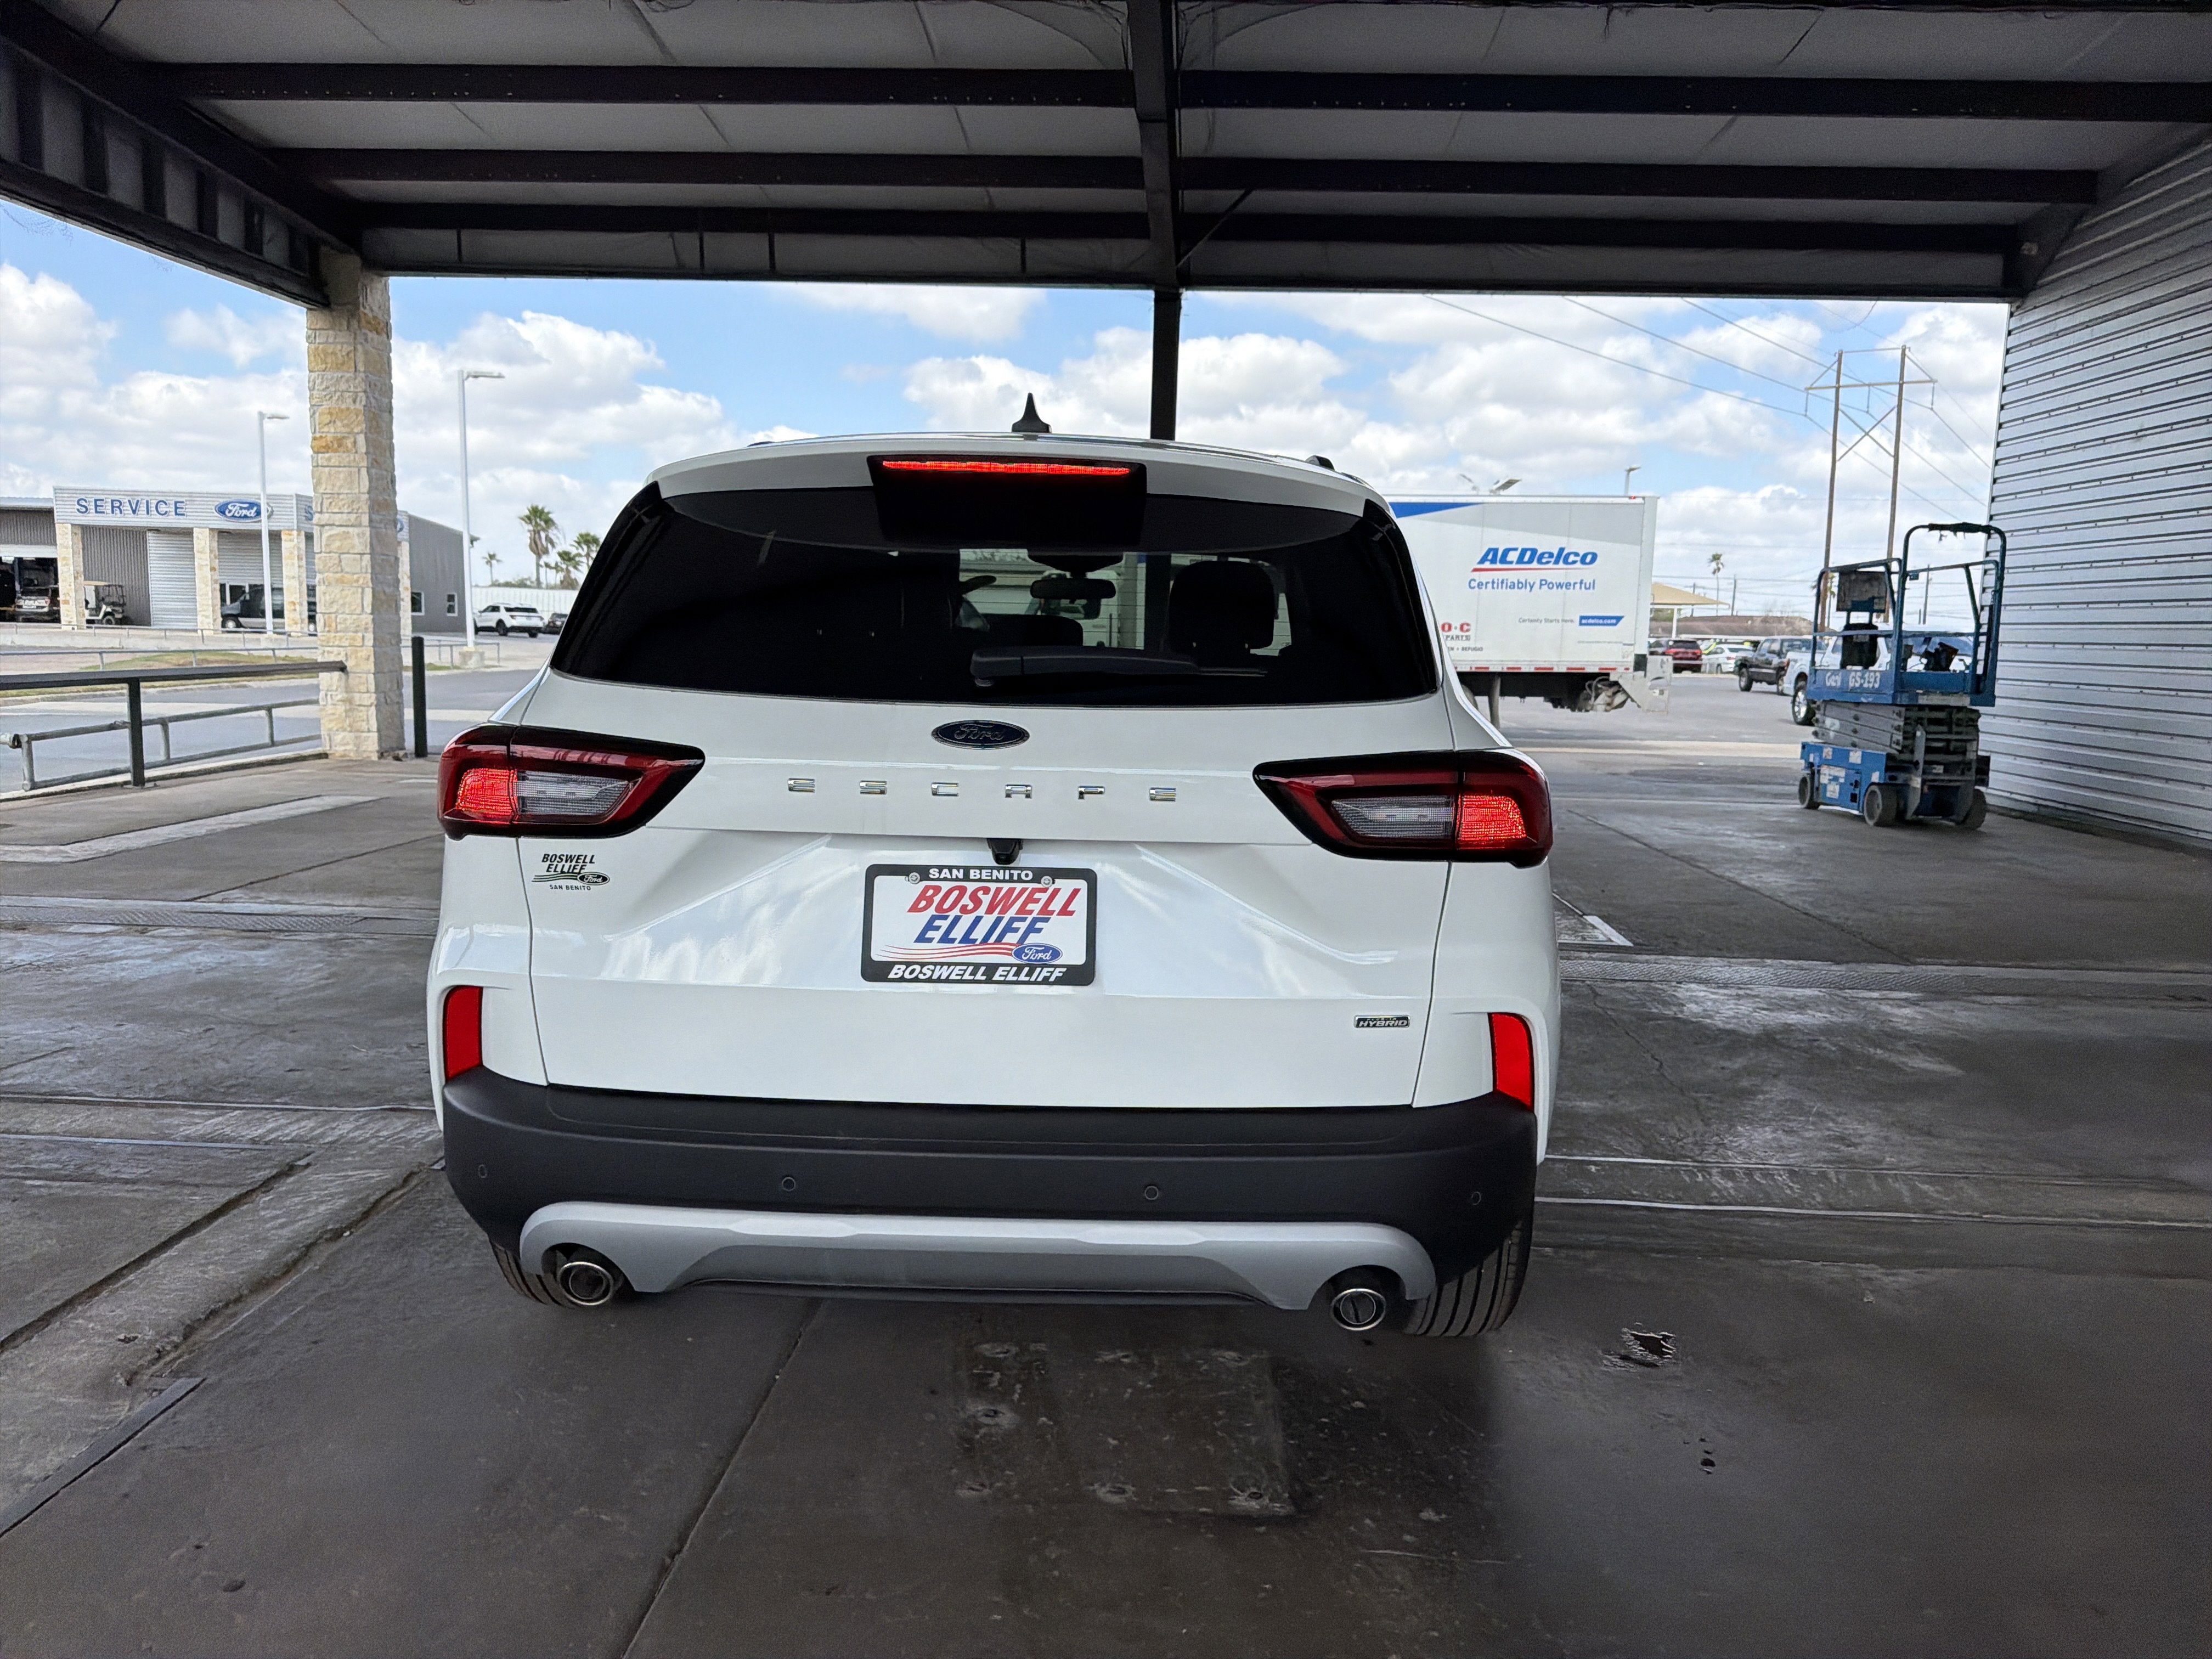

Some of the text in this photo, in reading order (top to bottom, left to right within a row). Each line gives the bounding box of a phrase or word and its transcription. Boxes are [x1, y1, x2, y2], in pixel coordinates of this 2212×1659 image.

[76, 498, 186, 517] SERVICE
[1476, 547, 1598, 565] ACDelco
[1468, 578, 1595, 592] Certifiably Powerful
[787, 777, 1176, 803] ESCAPE
[541, 854, 595, 864] BOSWELL
[546, 864, 586, 873] ELLIFF
[929, 868, 1033, 881] SAN BENITO
[906, 885, 1081, 916] BOSWELL
[913, 915, 1051, 944] ELLIFF
[887, 964, 1066, 982] BOSWELL ELLIFF
